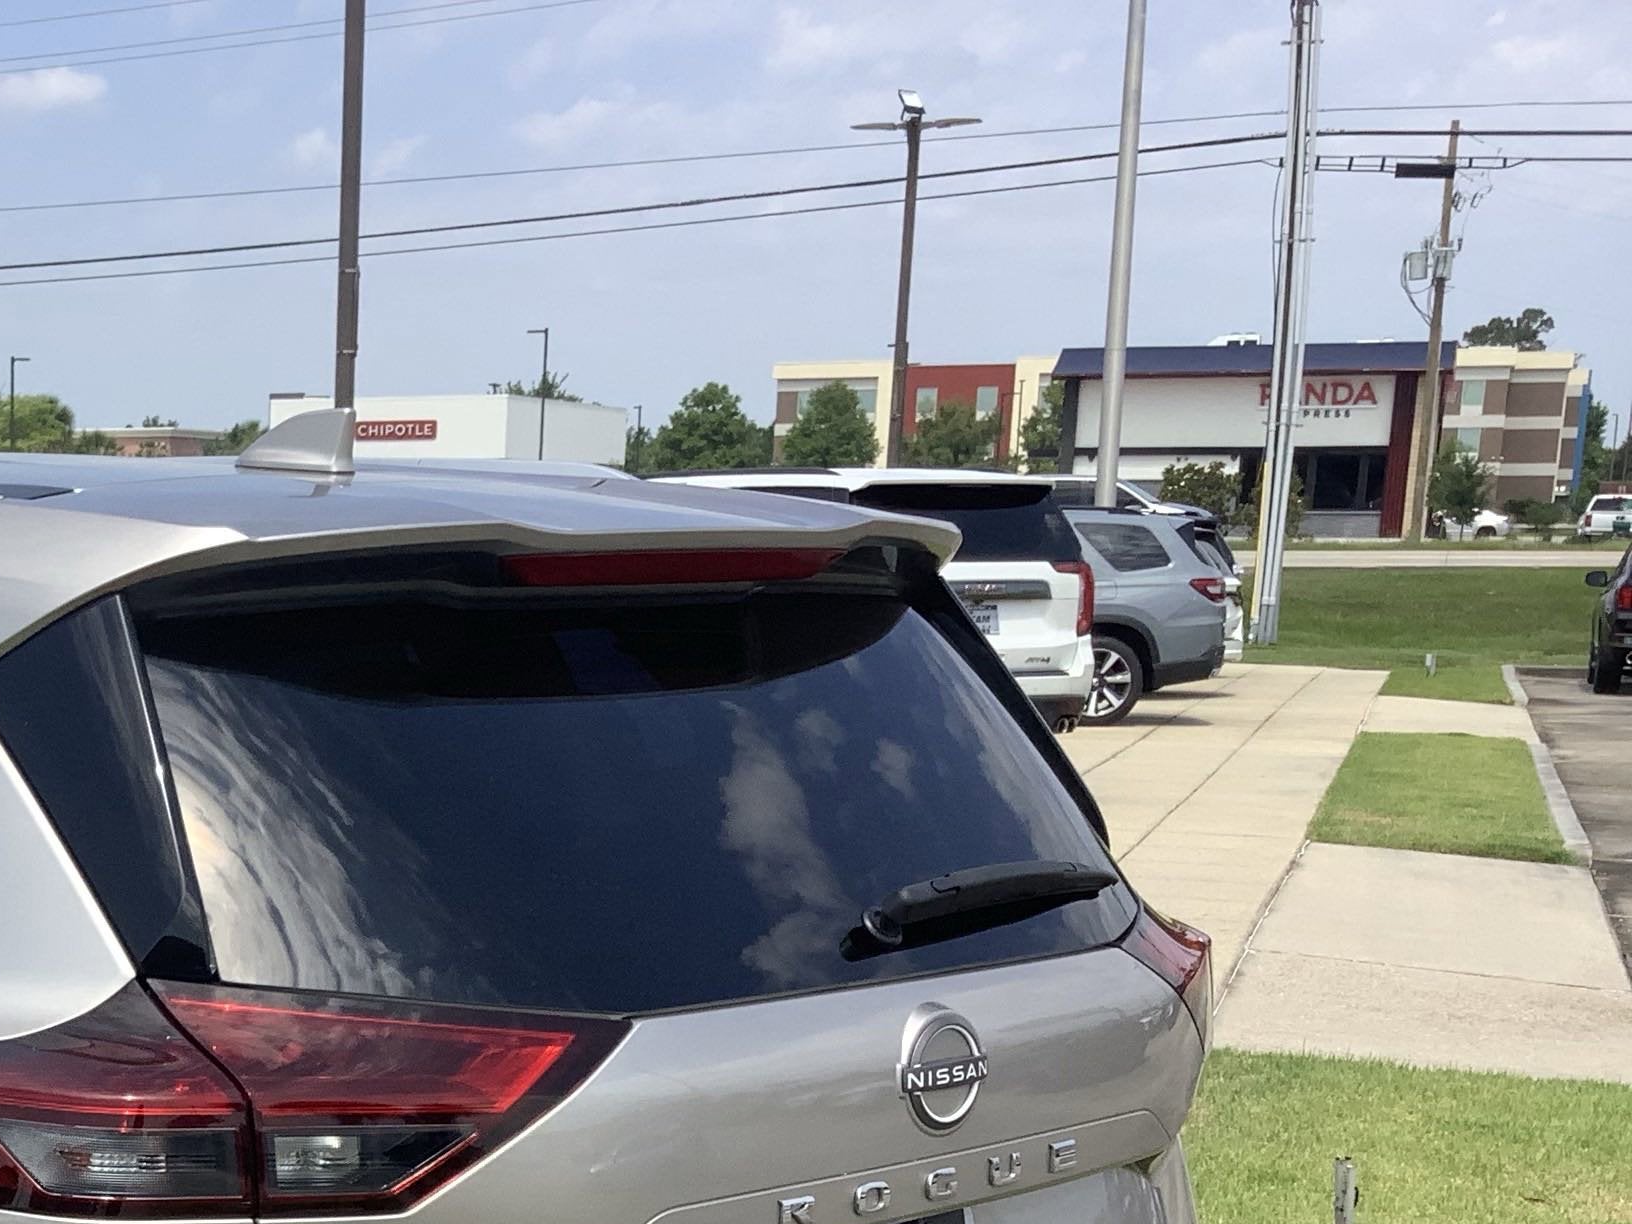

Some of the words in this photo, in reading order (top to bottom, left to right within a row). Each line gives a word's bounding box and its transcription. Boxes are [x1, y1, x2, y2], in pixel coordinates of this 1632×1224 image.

[1259, 381, 1378, 406] PNDA
[1303, 408, 1351, 418] PRESS
[357, 423, 433, 437] CHIPOTLE
[907, 1059, 988, 1090] NISSAN
